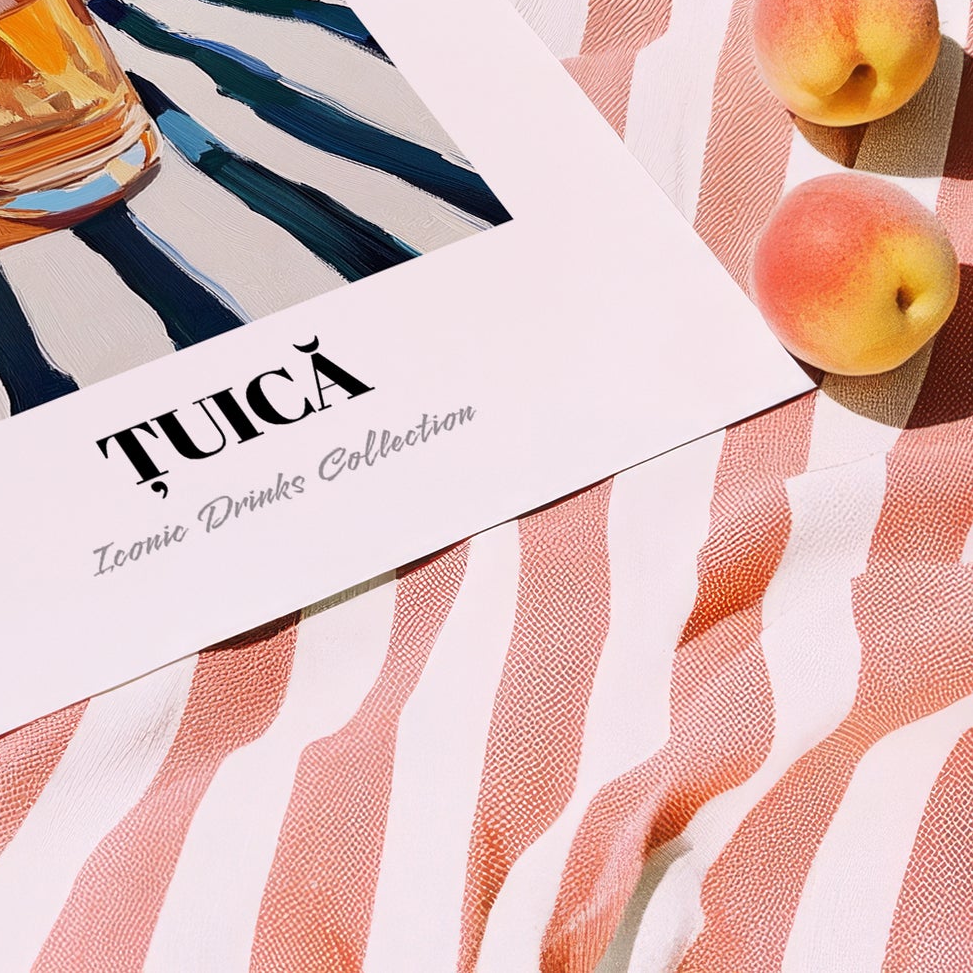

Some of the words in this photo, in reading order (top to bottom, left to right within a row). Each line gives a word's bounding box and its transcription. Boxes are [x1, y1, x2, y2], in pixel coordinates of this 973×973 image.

[93, 524, 189, 577] Iconic
[197, 472, 306, 533] Drinks
[318, 404, 477, 482] Collection
[95, 335, 376, 499] ȚUICĂ
